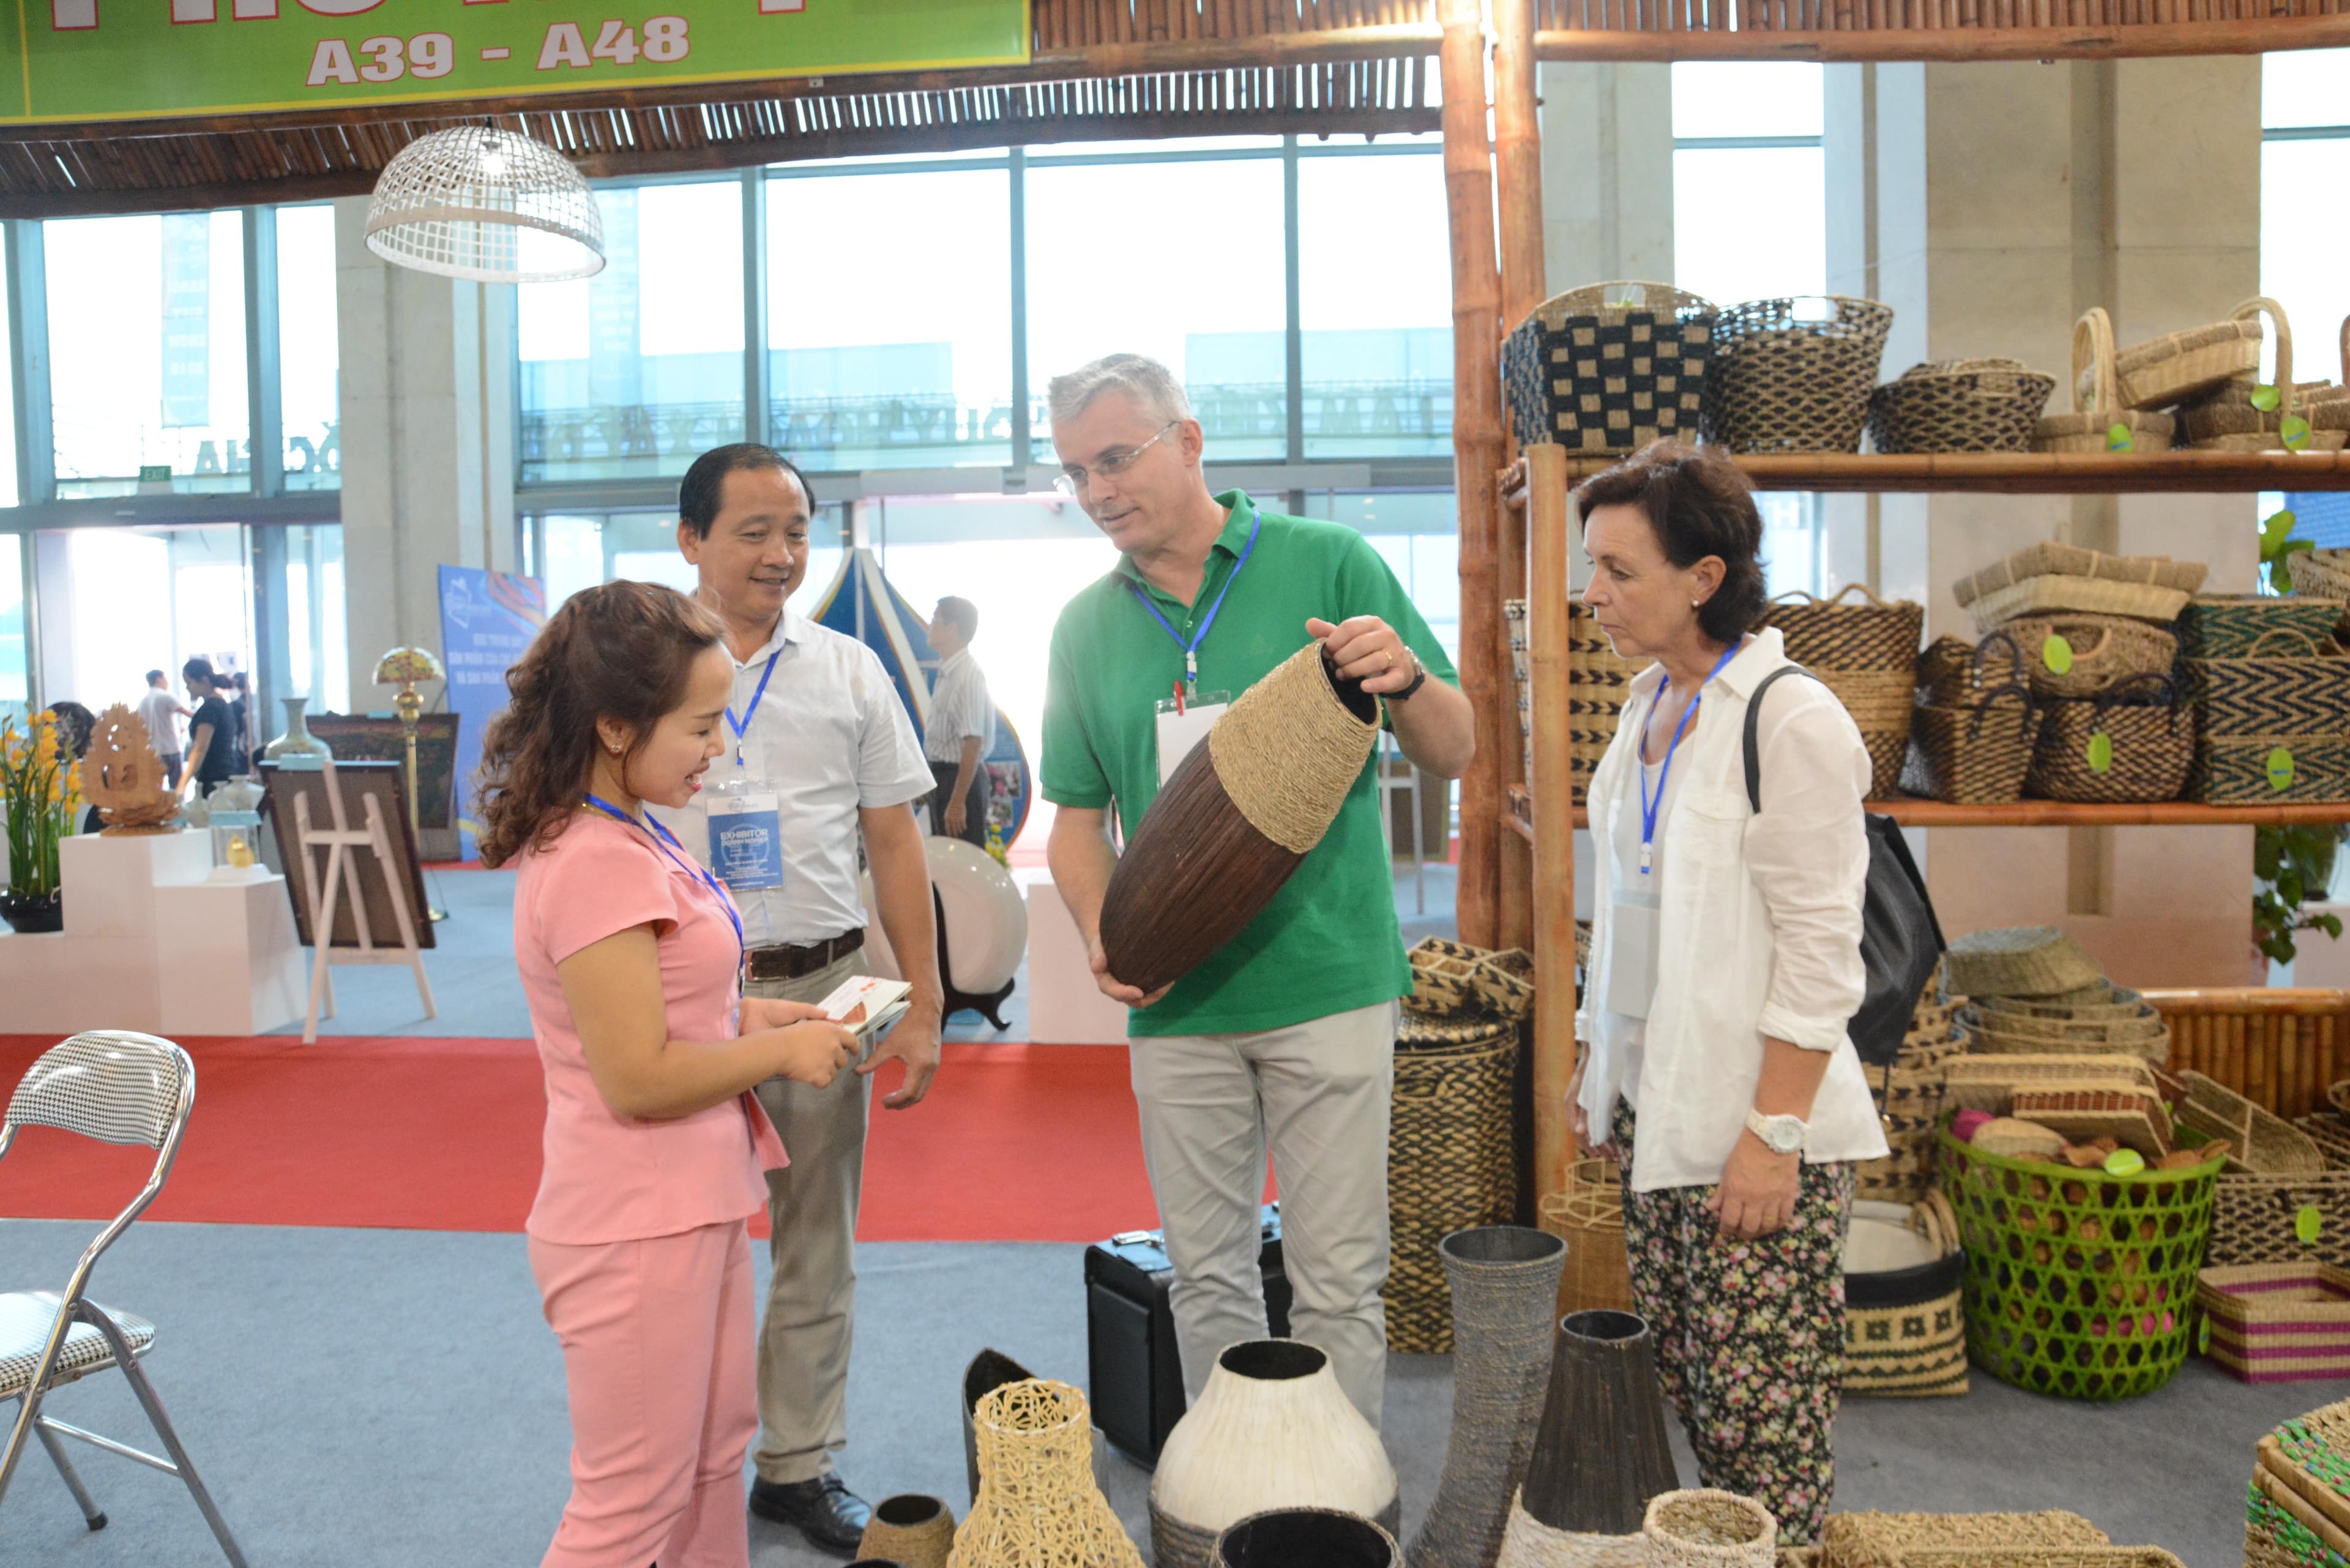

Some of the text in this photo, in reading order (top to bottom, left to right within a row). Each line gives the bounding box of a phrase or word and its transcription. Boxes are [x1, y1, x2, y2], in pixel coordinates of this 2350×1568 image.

[306, 15, 691, 86] A39 - A48
[144, 468, 166, 480] EXIT
[720, 828, 769, 840] EXHIBITOR
